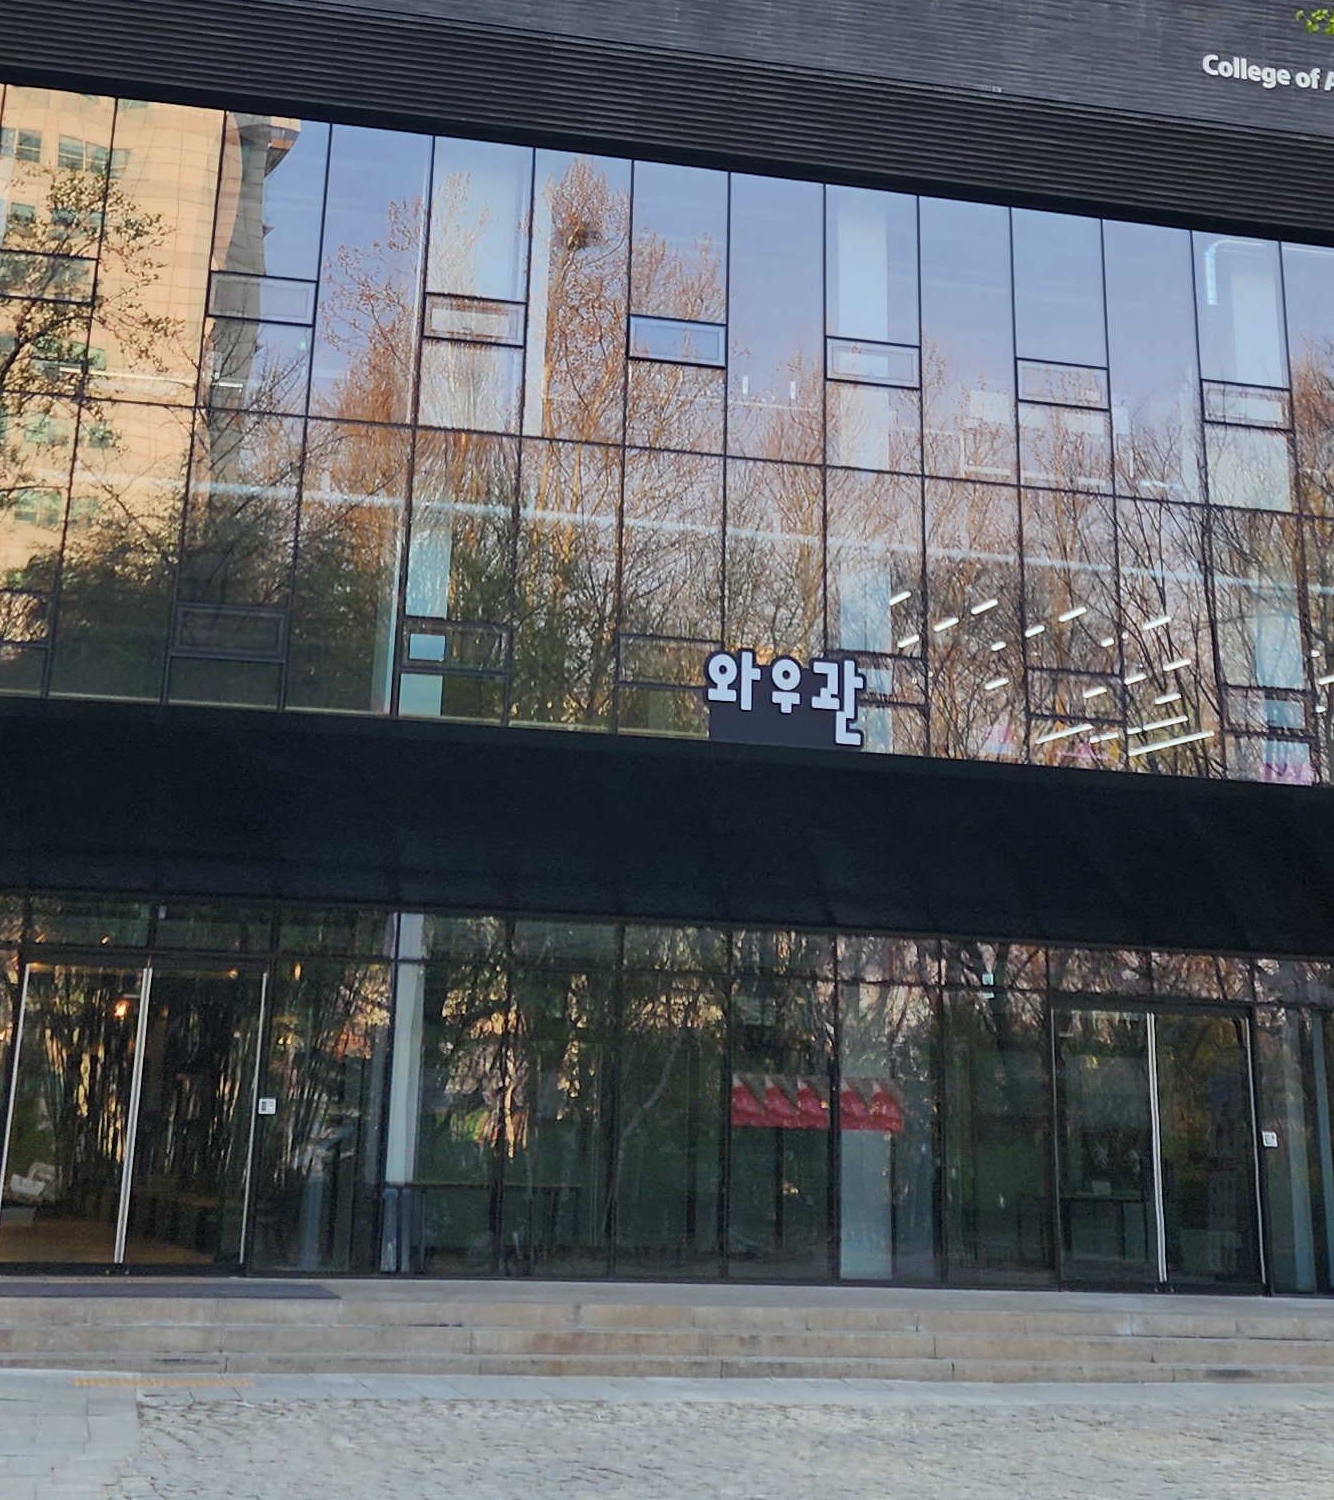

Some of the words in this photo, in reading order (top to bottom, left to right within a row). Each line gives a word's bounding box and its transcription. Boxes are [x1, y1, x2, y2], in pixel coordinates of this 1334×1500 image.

[1202, 54, 1292, 89] College
[1295, 67, 1321, 90] of
[707, 650, 865, 747] 와우관
